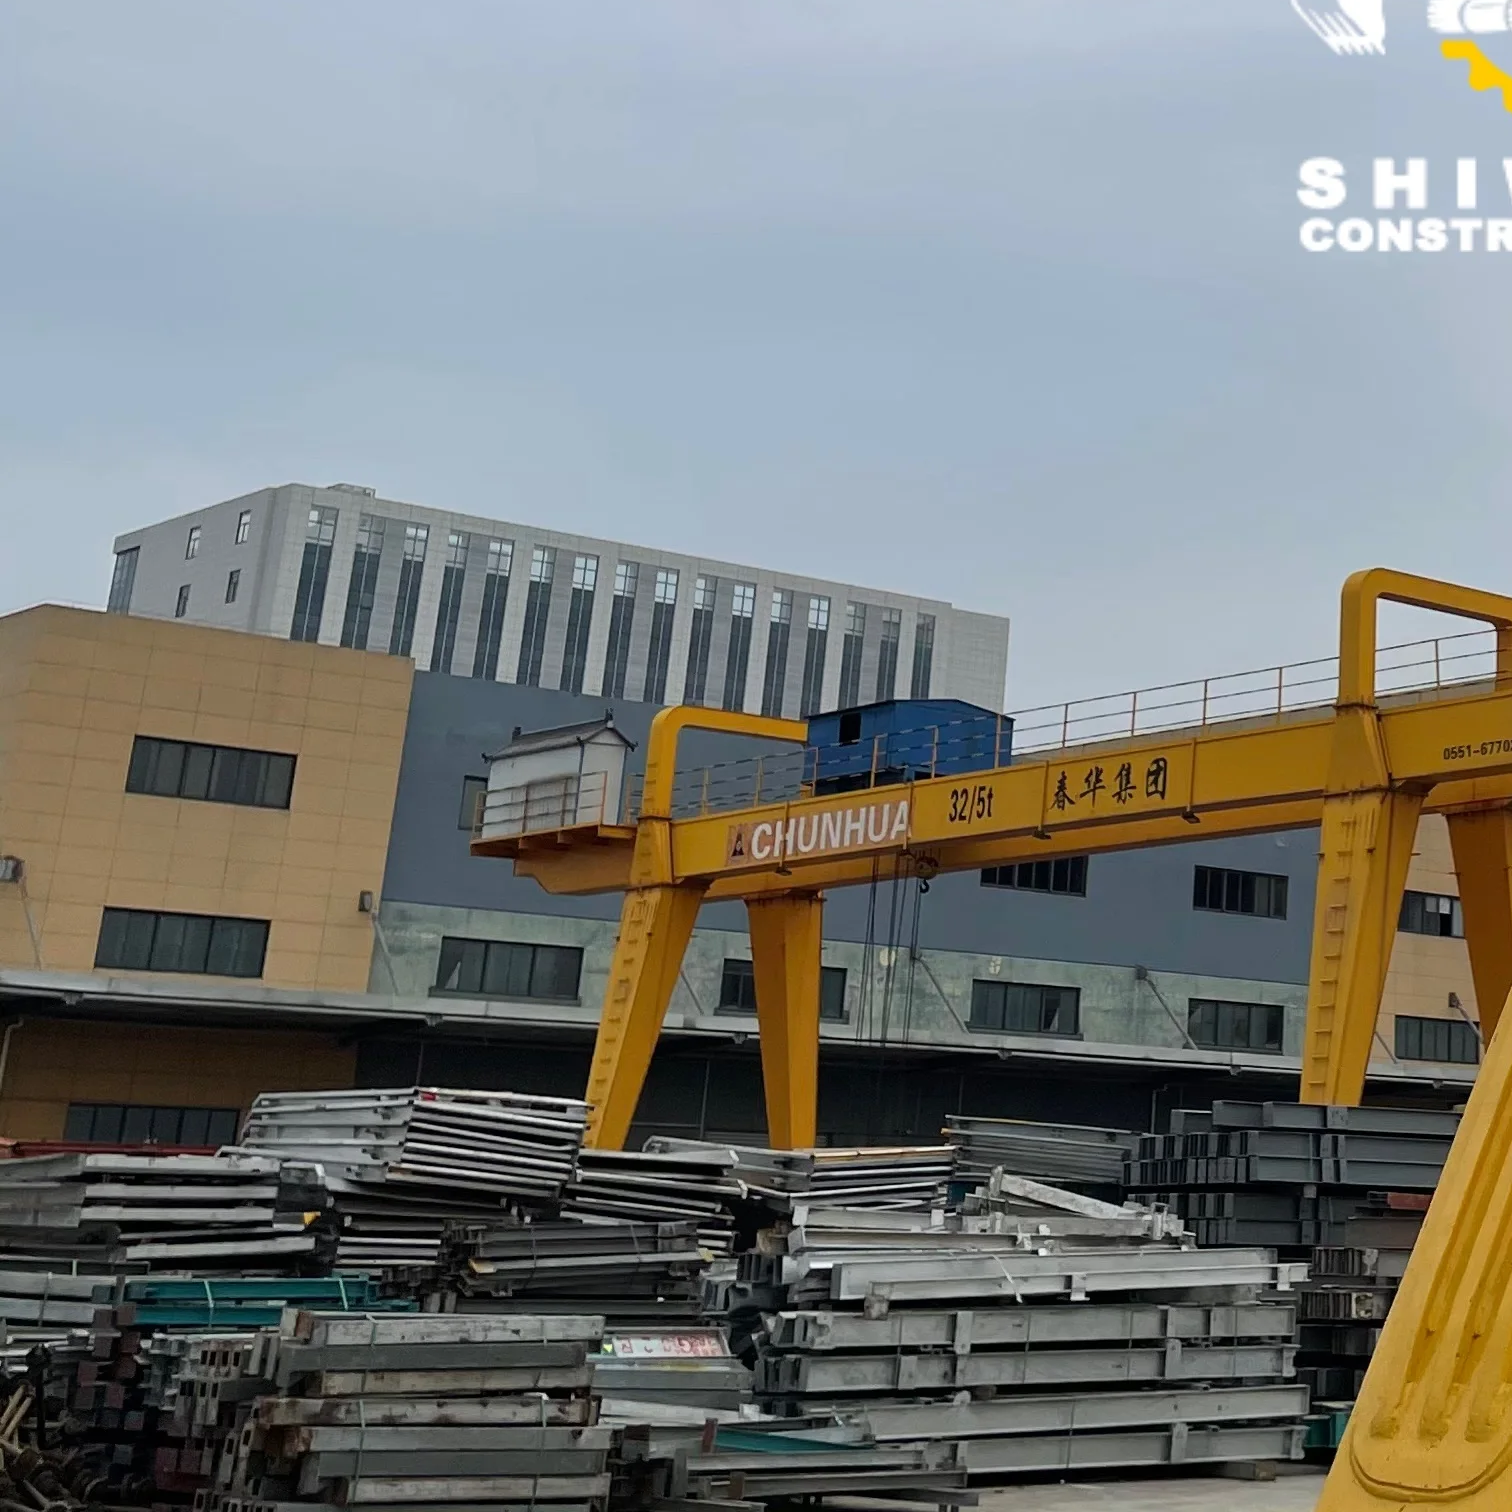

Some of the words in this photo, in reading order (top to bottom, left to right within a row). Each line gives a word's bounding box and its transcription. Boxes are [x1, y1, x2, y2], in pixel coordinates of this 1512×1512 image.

[949, 785, 994, 825] 32/5t
[1050, 757, 1168, 811] 春华集团
[751, 800, 912, 860] CHUNHUA
